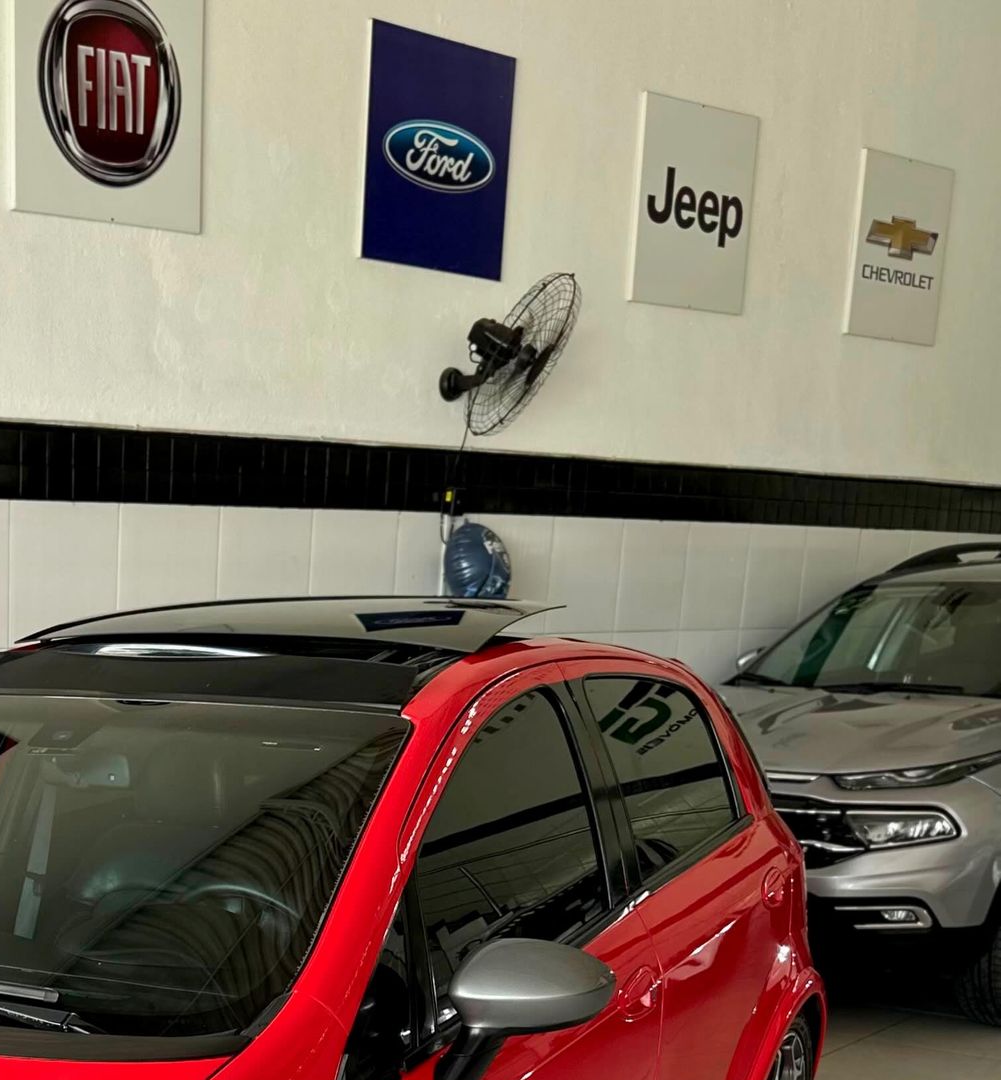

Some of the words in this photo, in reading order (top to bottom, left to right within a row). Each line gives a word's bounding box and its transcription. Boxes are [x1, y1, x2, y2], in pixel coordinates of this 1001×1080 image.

[77, 44, 151, 135] FIAT
[405, 129, 474, 182] Ford
[647, 166, 743, 248] Jeep
[862, 264, 934, 290] CHEVROLET
